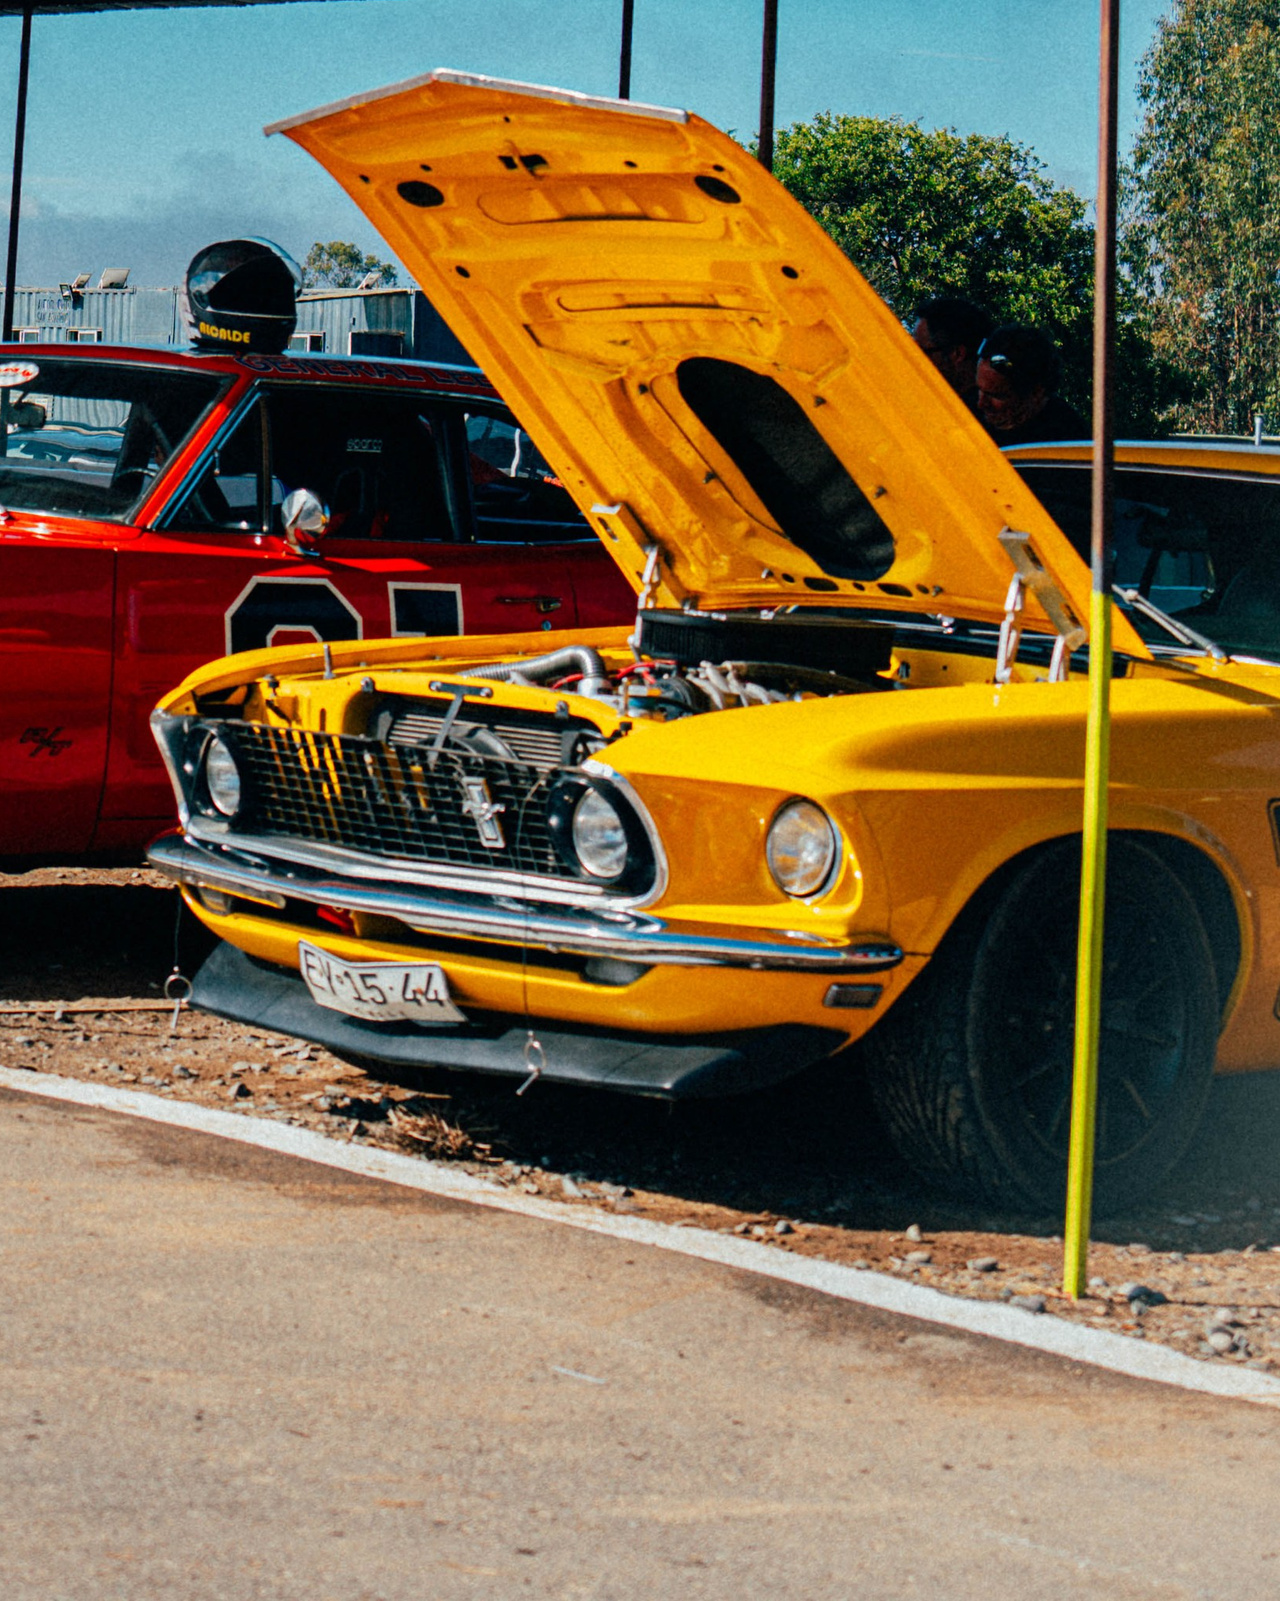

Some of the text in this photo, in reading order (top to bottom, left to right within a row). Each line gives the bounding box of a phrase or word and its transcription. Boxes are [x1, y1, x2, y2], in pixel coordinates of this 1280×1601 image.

[199, 321, 251, 344] ALCALDE
[234, 355, 426, 384] GENERAL
[19, 726, 73, 757] R/T
